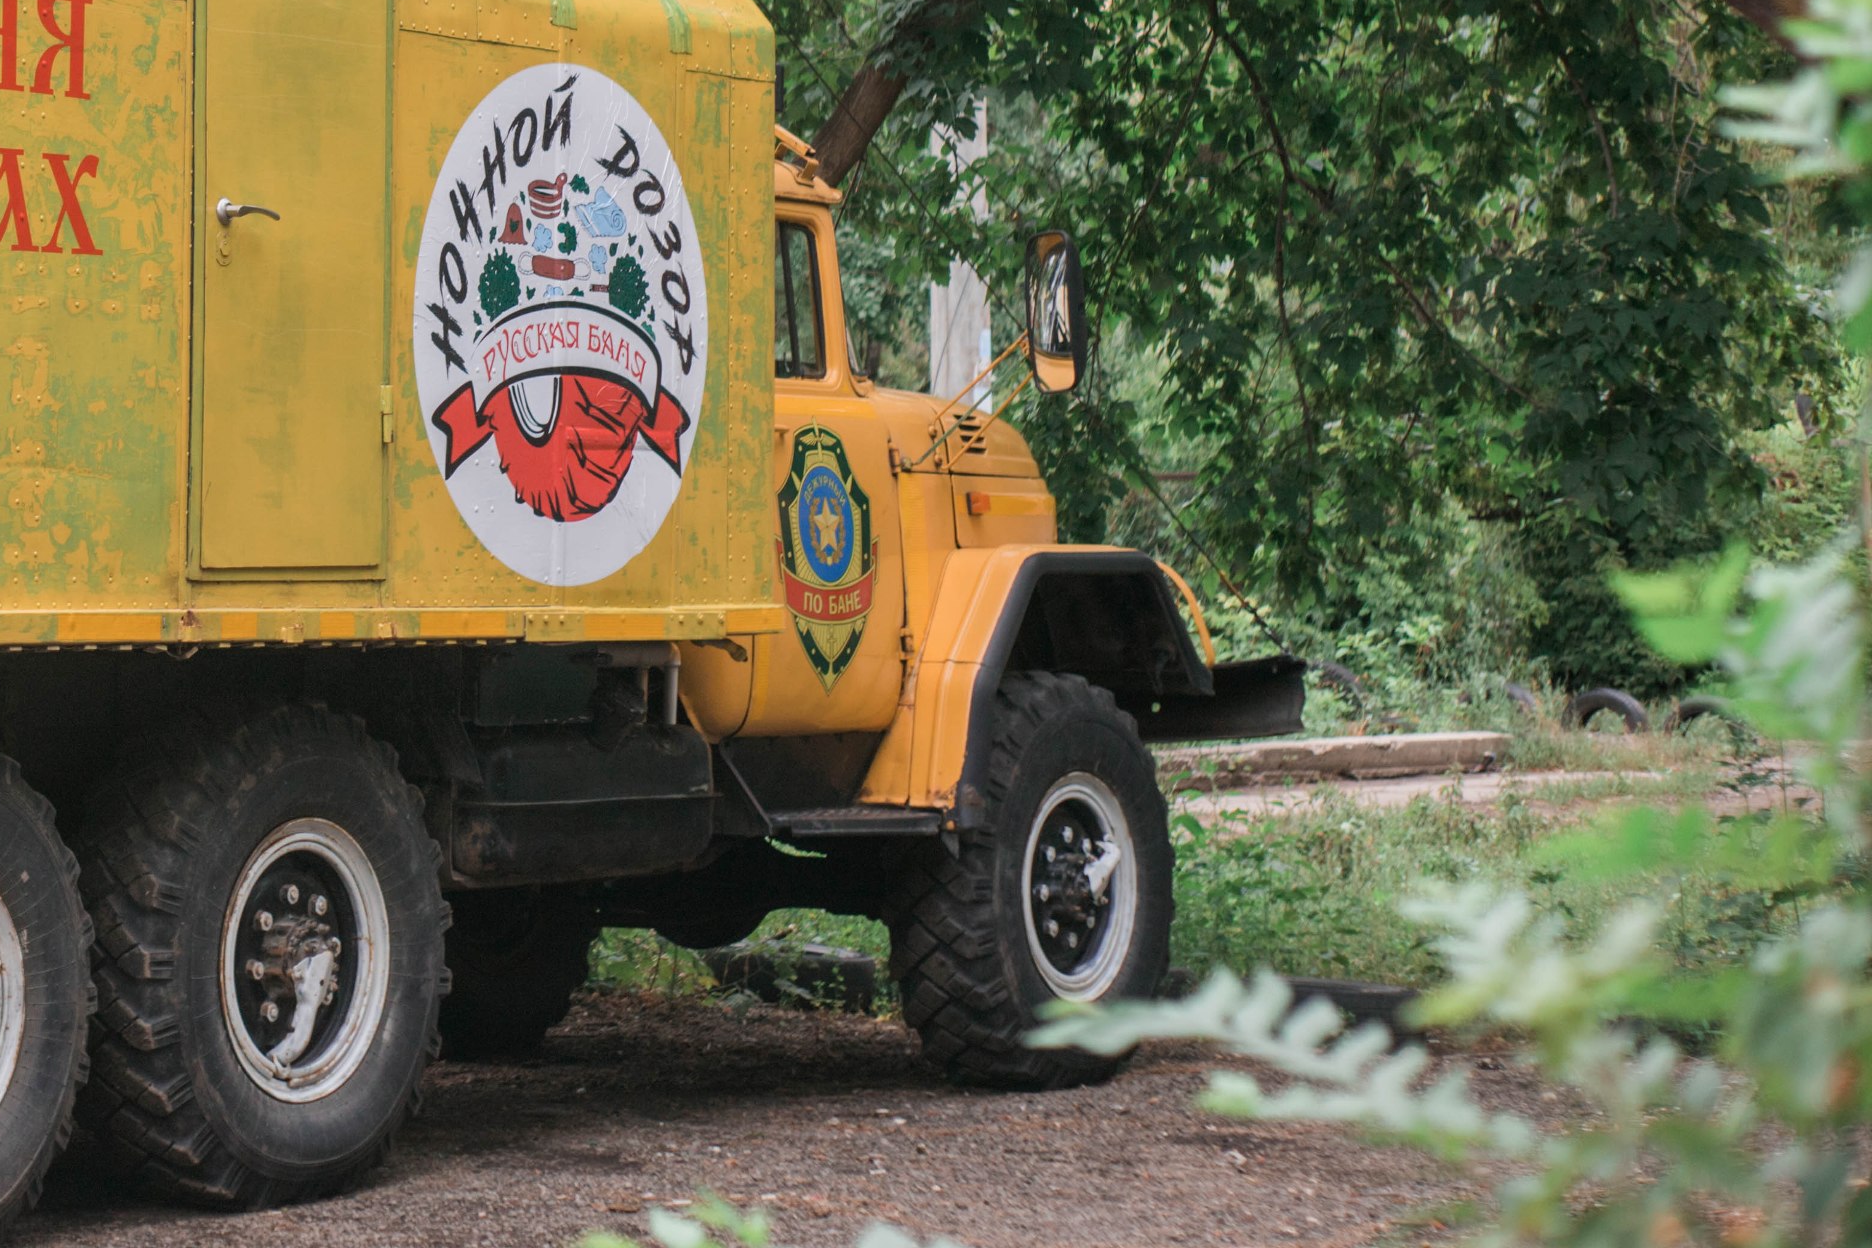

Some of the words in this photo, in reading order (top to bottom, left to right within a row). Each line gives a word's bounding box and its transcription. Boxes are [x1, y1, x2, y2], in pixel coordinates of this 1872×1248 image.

[425, 72, 580, 376] НОЧНОЙ
[593, 123, 700, 376] ДОЗОР
[483, 321, 580, 383] РУССКАЯ
[587, 323, 647, 384] БАНЯ
[803, 591, 824, 615] ПО
[828, 590, 863, 615] БАНЕ
